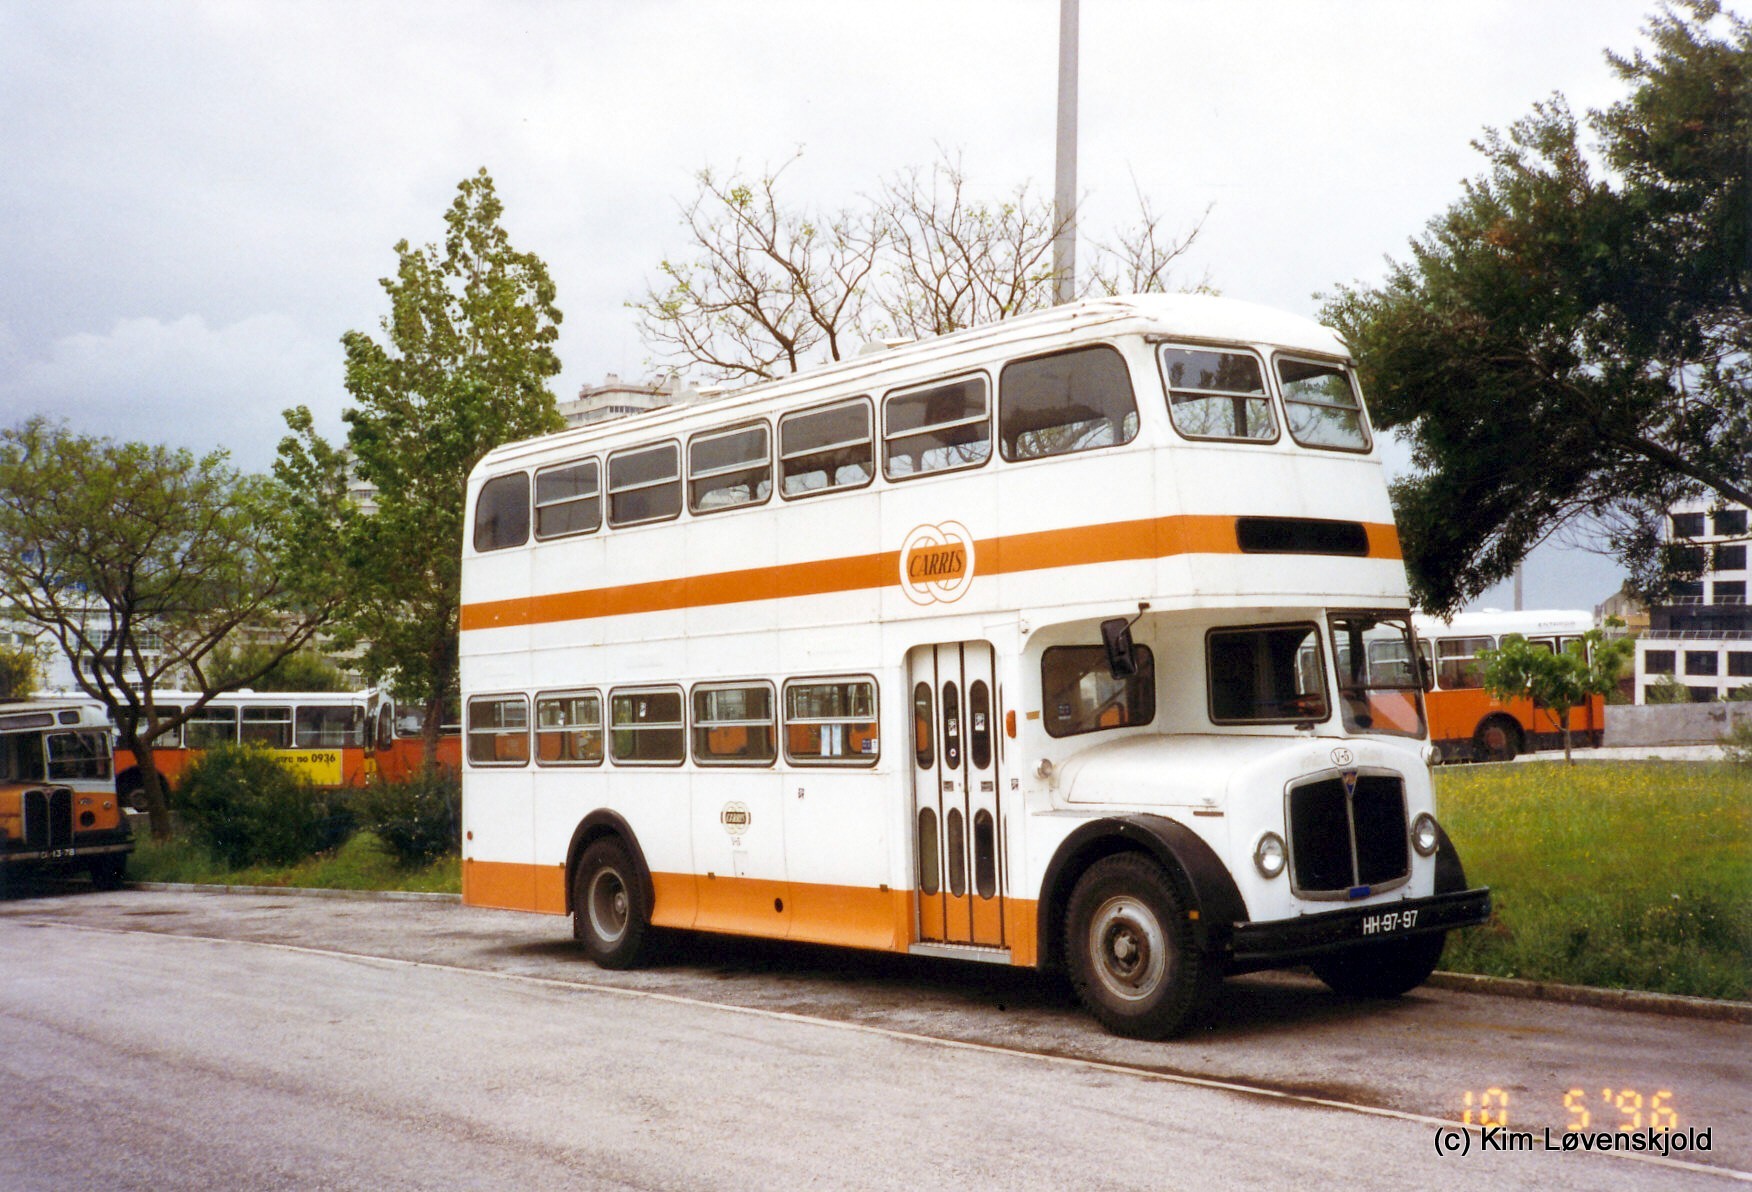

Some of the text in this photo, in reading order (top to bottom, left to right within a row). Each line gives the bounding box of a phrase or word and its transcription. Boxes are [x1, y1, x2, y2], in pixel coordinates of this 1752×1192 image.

[909, 549, 963, 578] CARRIS
[311, 753, 336, 763] 0936
[1363, 909, 1419, 935] HH-97-97
